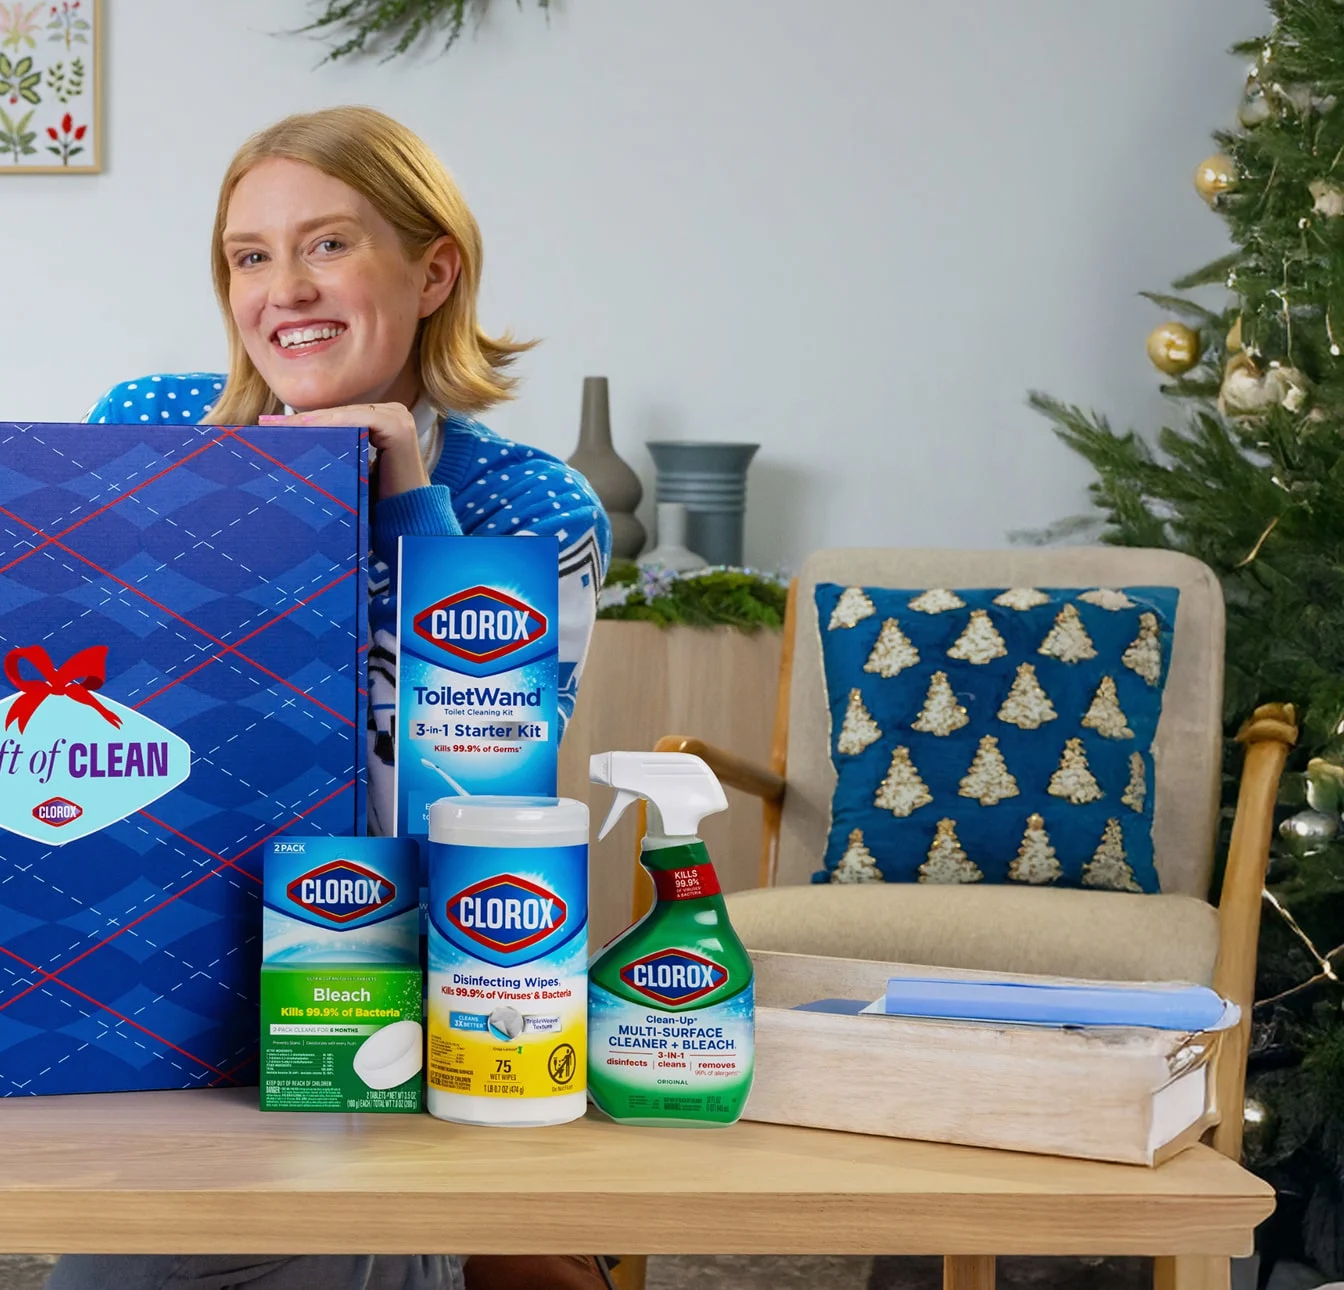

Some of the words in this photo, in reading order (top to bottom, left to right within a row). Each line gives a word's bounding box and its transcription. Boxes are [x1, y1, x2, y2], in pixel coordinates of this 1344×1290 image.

[432, 609, 530, 641] CLOROX
[467, 709, 500, 717] Cleaning
[416, 723, 448, 736] 3-in-1
[455, 724, 512, 737] Starter
[518, 724, 541, 737] Kit
[434, 744, 451, 752] Kills
[453, 744, 480, 752] 99.9%
[29, 738, 66, 784] of
[68, 742, 168, 778] CLEAN
[39, 806, 76, 818] CLOROX
[675, 870, 697, 879] KILLS
[676, 879, 699, 887] 99.9%
[301, 879, 381, 904] CLOROX
[460, 897, 554, 929] CLOROX
[453, 974, 520, 989] Disinfecting
[634, 965, 714, 987] CLOROX
[314, 988, 371, 1001] Bleach
[442, 986, 454, 994] Kills
[456, 987, 484, 998] 99.9%
[486, 990, 495, 999] of
[542, 989, 571, 998] Bacteria
[281, 1008, 304, 1017] Kills
[306, 1008, 339, 1017] 99.9%
[342, 1008, 353, 1017] of
[619, 1025, 723, 1037] MULTI-SURFACE
[608, 1037, 667, 1049] CLEANER
[496, 1060, 511, 1073] 75
[607, 1058, 648, 1066] disinfects
